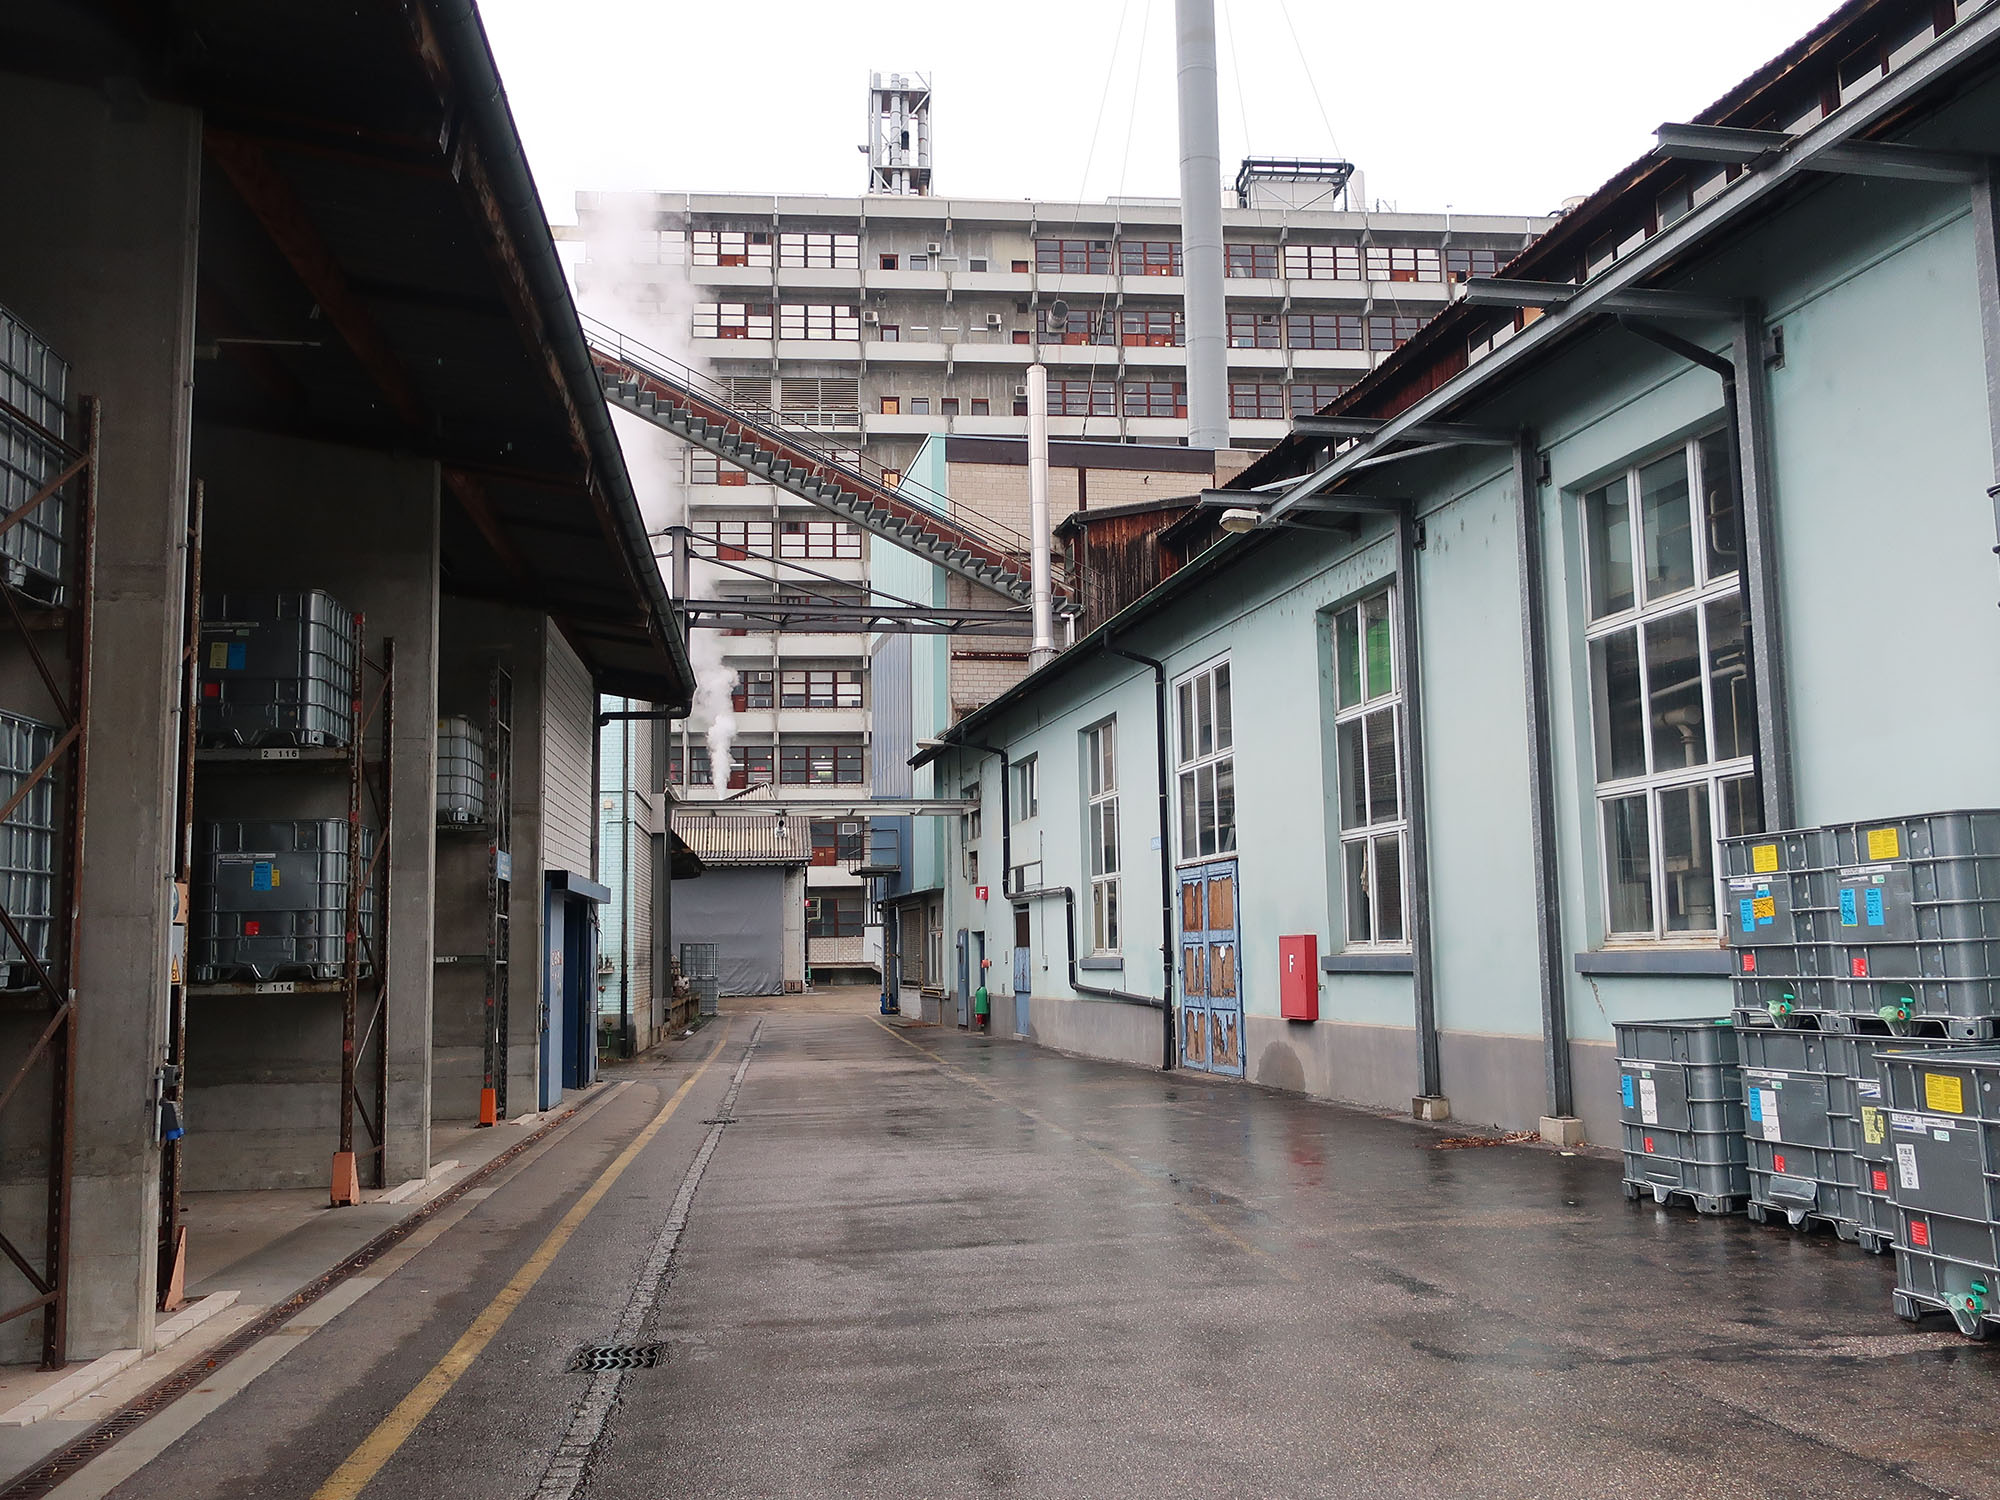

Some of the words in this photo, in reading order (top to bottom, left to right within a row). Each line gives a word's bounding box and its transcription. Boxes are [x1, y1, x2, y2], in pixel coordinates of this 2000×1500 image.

[278, 750, 297, 758] 116
[979, 889, 986, 900] F
[1289, 954, 1294, 973] F
[273, 984, 292, 992] 114
